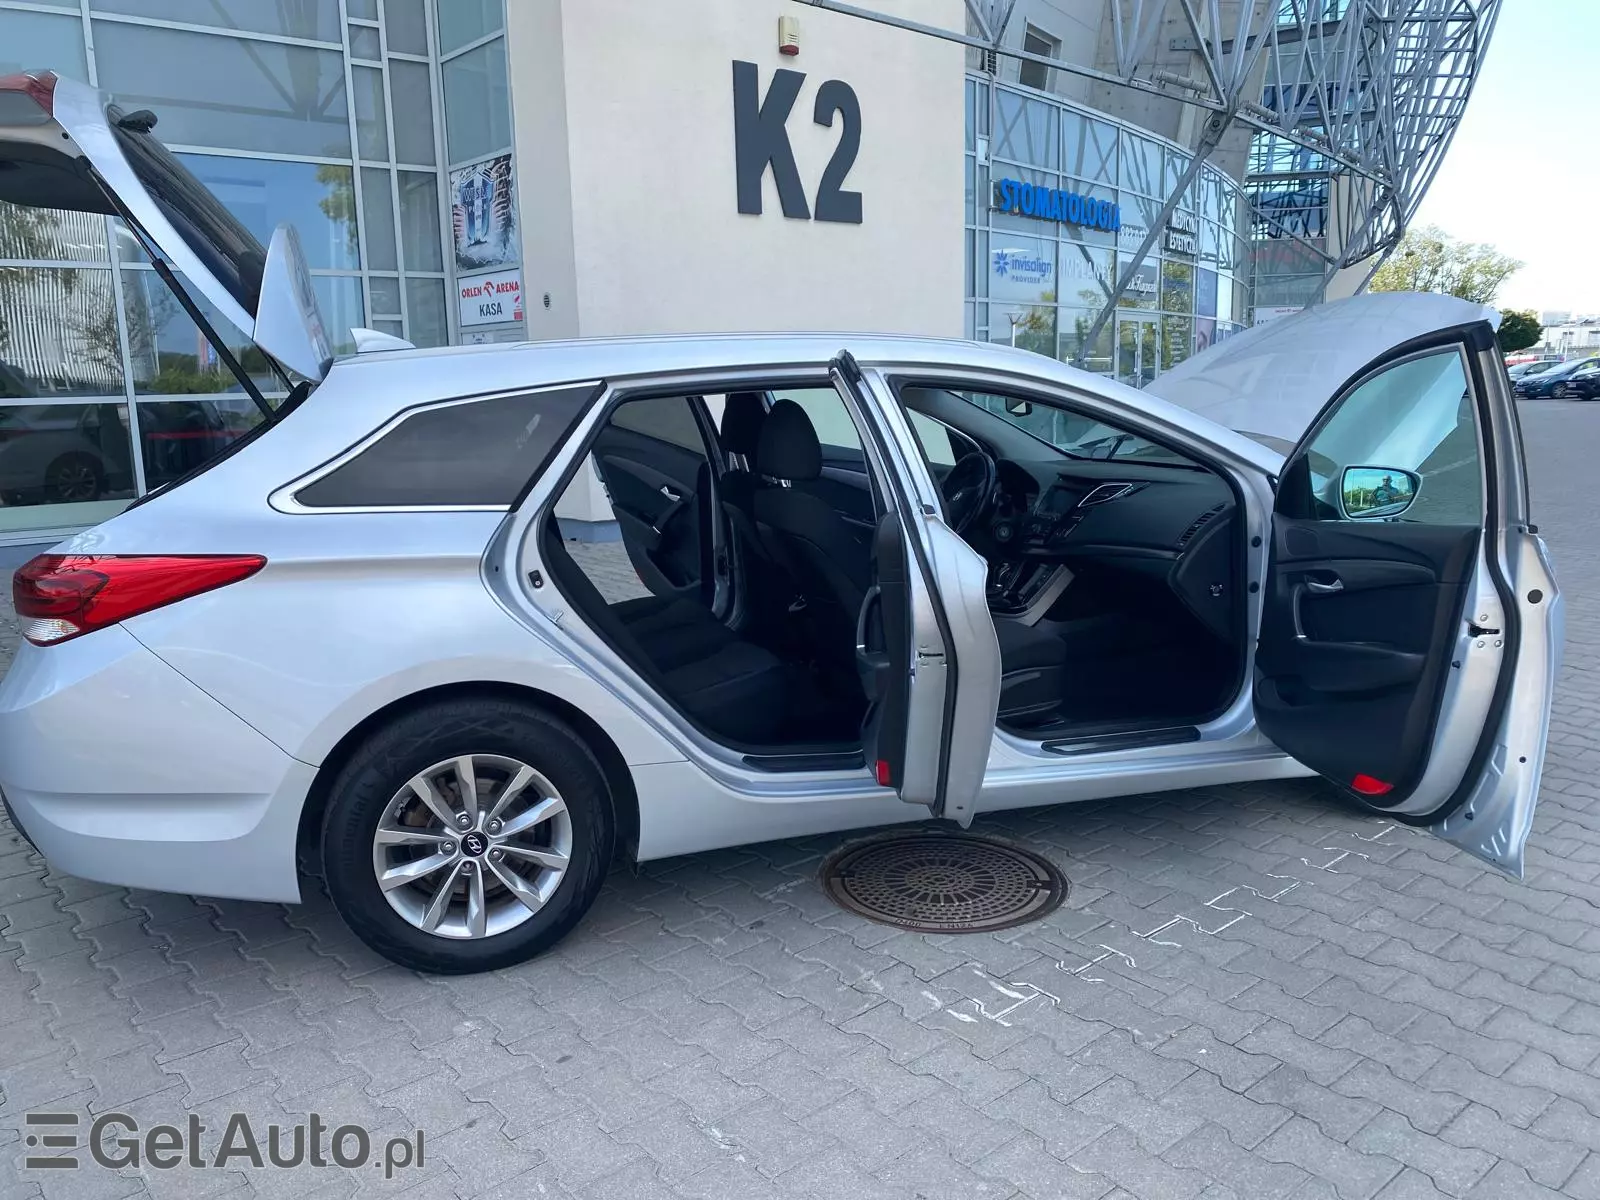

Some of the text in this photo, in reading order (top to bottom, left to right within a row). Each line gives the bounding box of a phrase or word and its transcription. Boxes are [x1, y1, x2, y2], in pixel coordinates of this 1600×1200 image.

[732, 59, 863, 224] K2
[1001, 178, 1120, 232] STOMATOLOGIA
[1011, 255, 1052, 277] invisalign
[461, 280, 520, 299] ORLEN ARENA
[1011, 275, 1041, 285] PROVIDER
[479, 301, 503, 317] KASA
